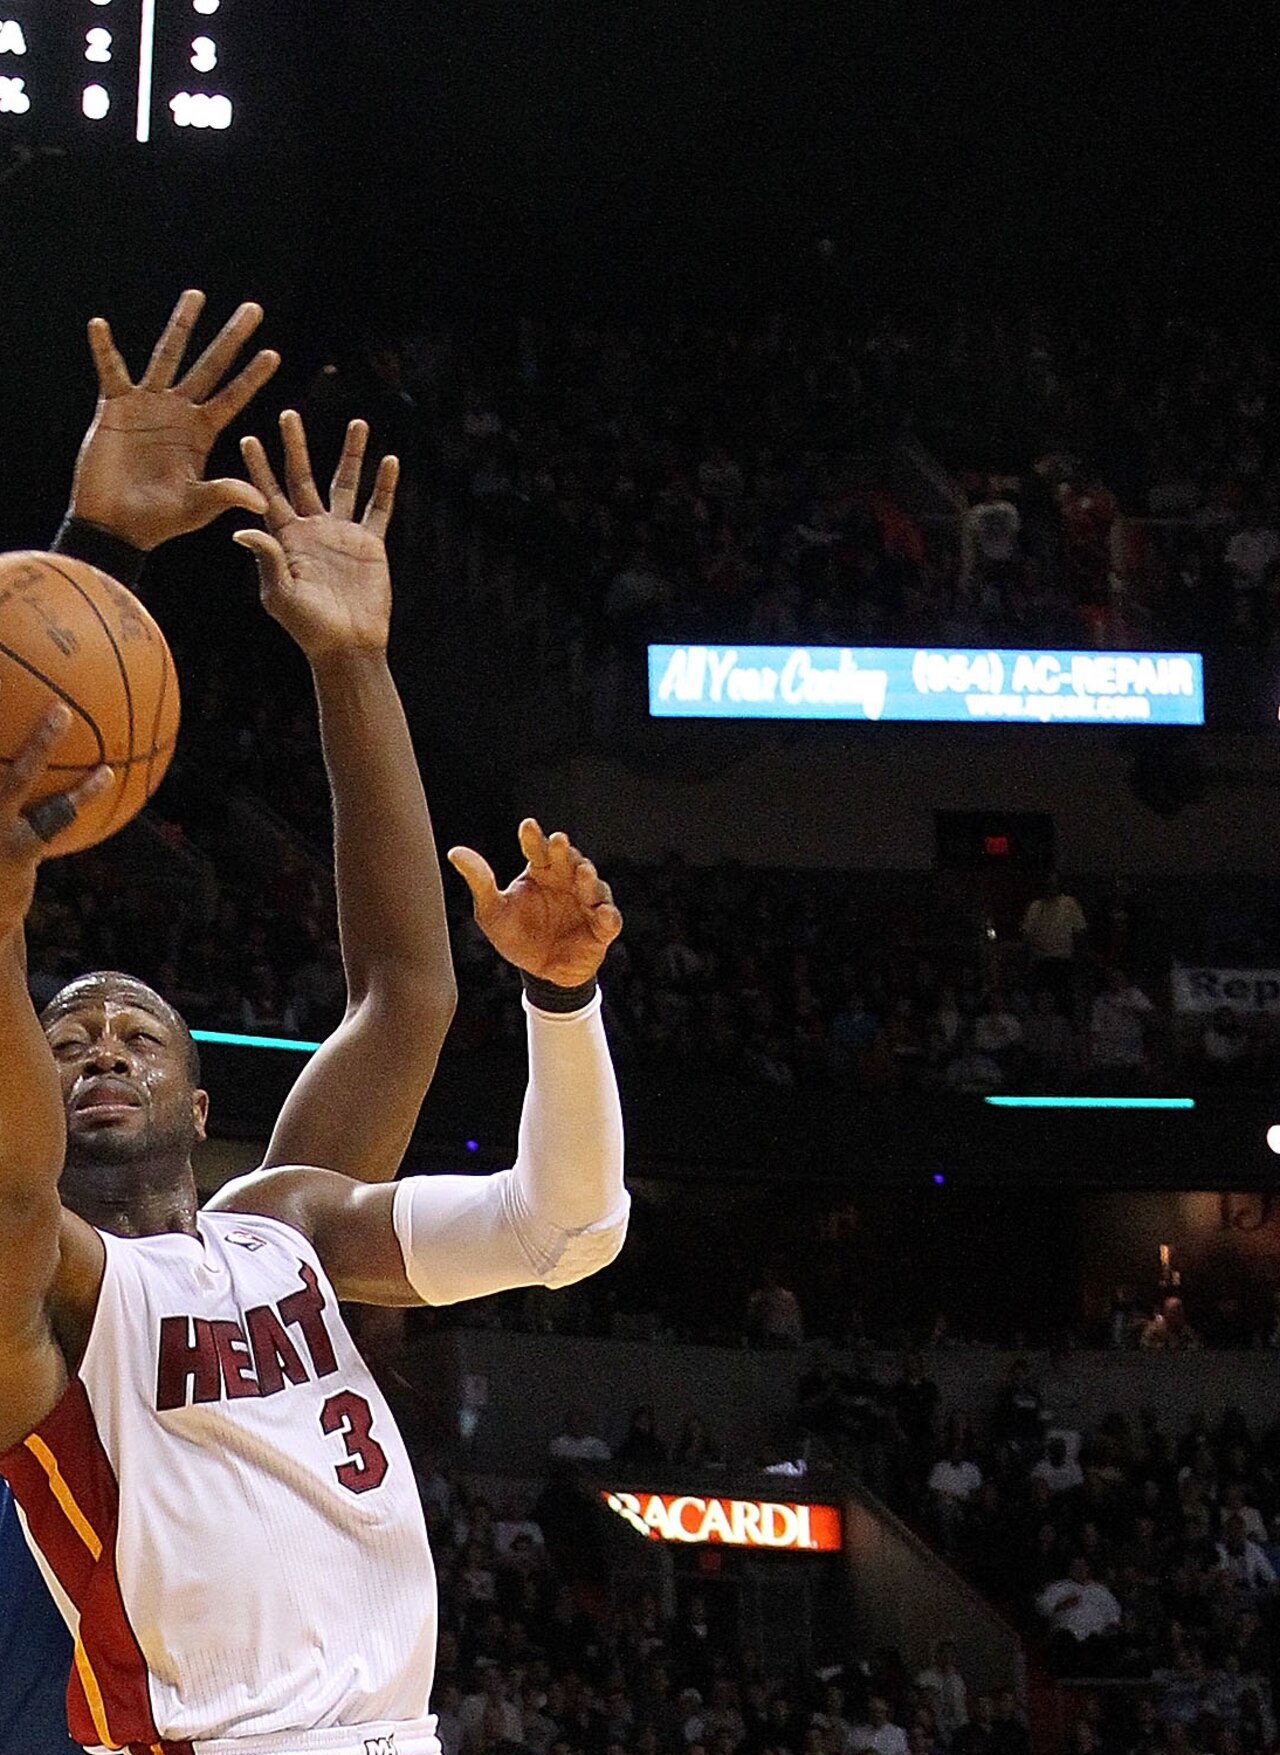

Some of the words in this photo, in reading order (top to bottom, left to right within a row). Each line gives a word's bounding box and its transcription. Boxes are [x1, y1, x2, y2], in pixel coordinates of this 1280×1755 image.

[85, 27, 112, 63] 2
[190, 36, 217, 73] 3
[1010, 656, 1195, 696] AC-REPAIR
[156, 1257, 339, 1412] HEAT
[319, 1389, 389, 1495] 3
